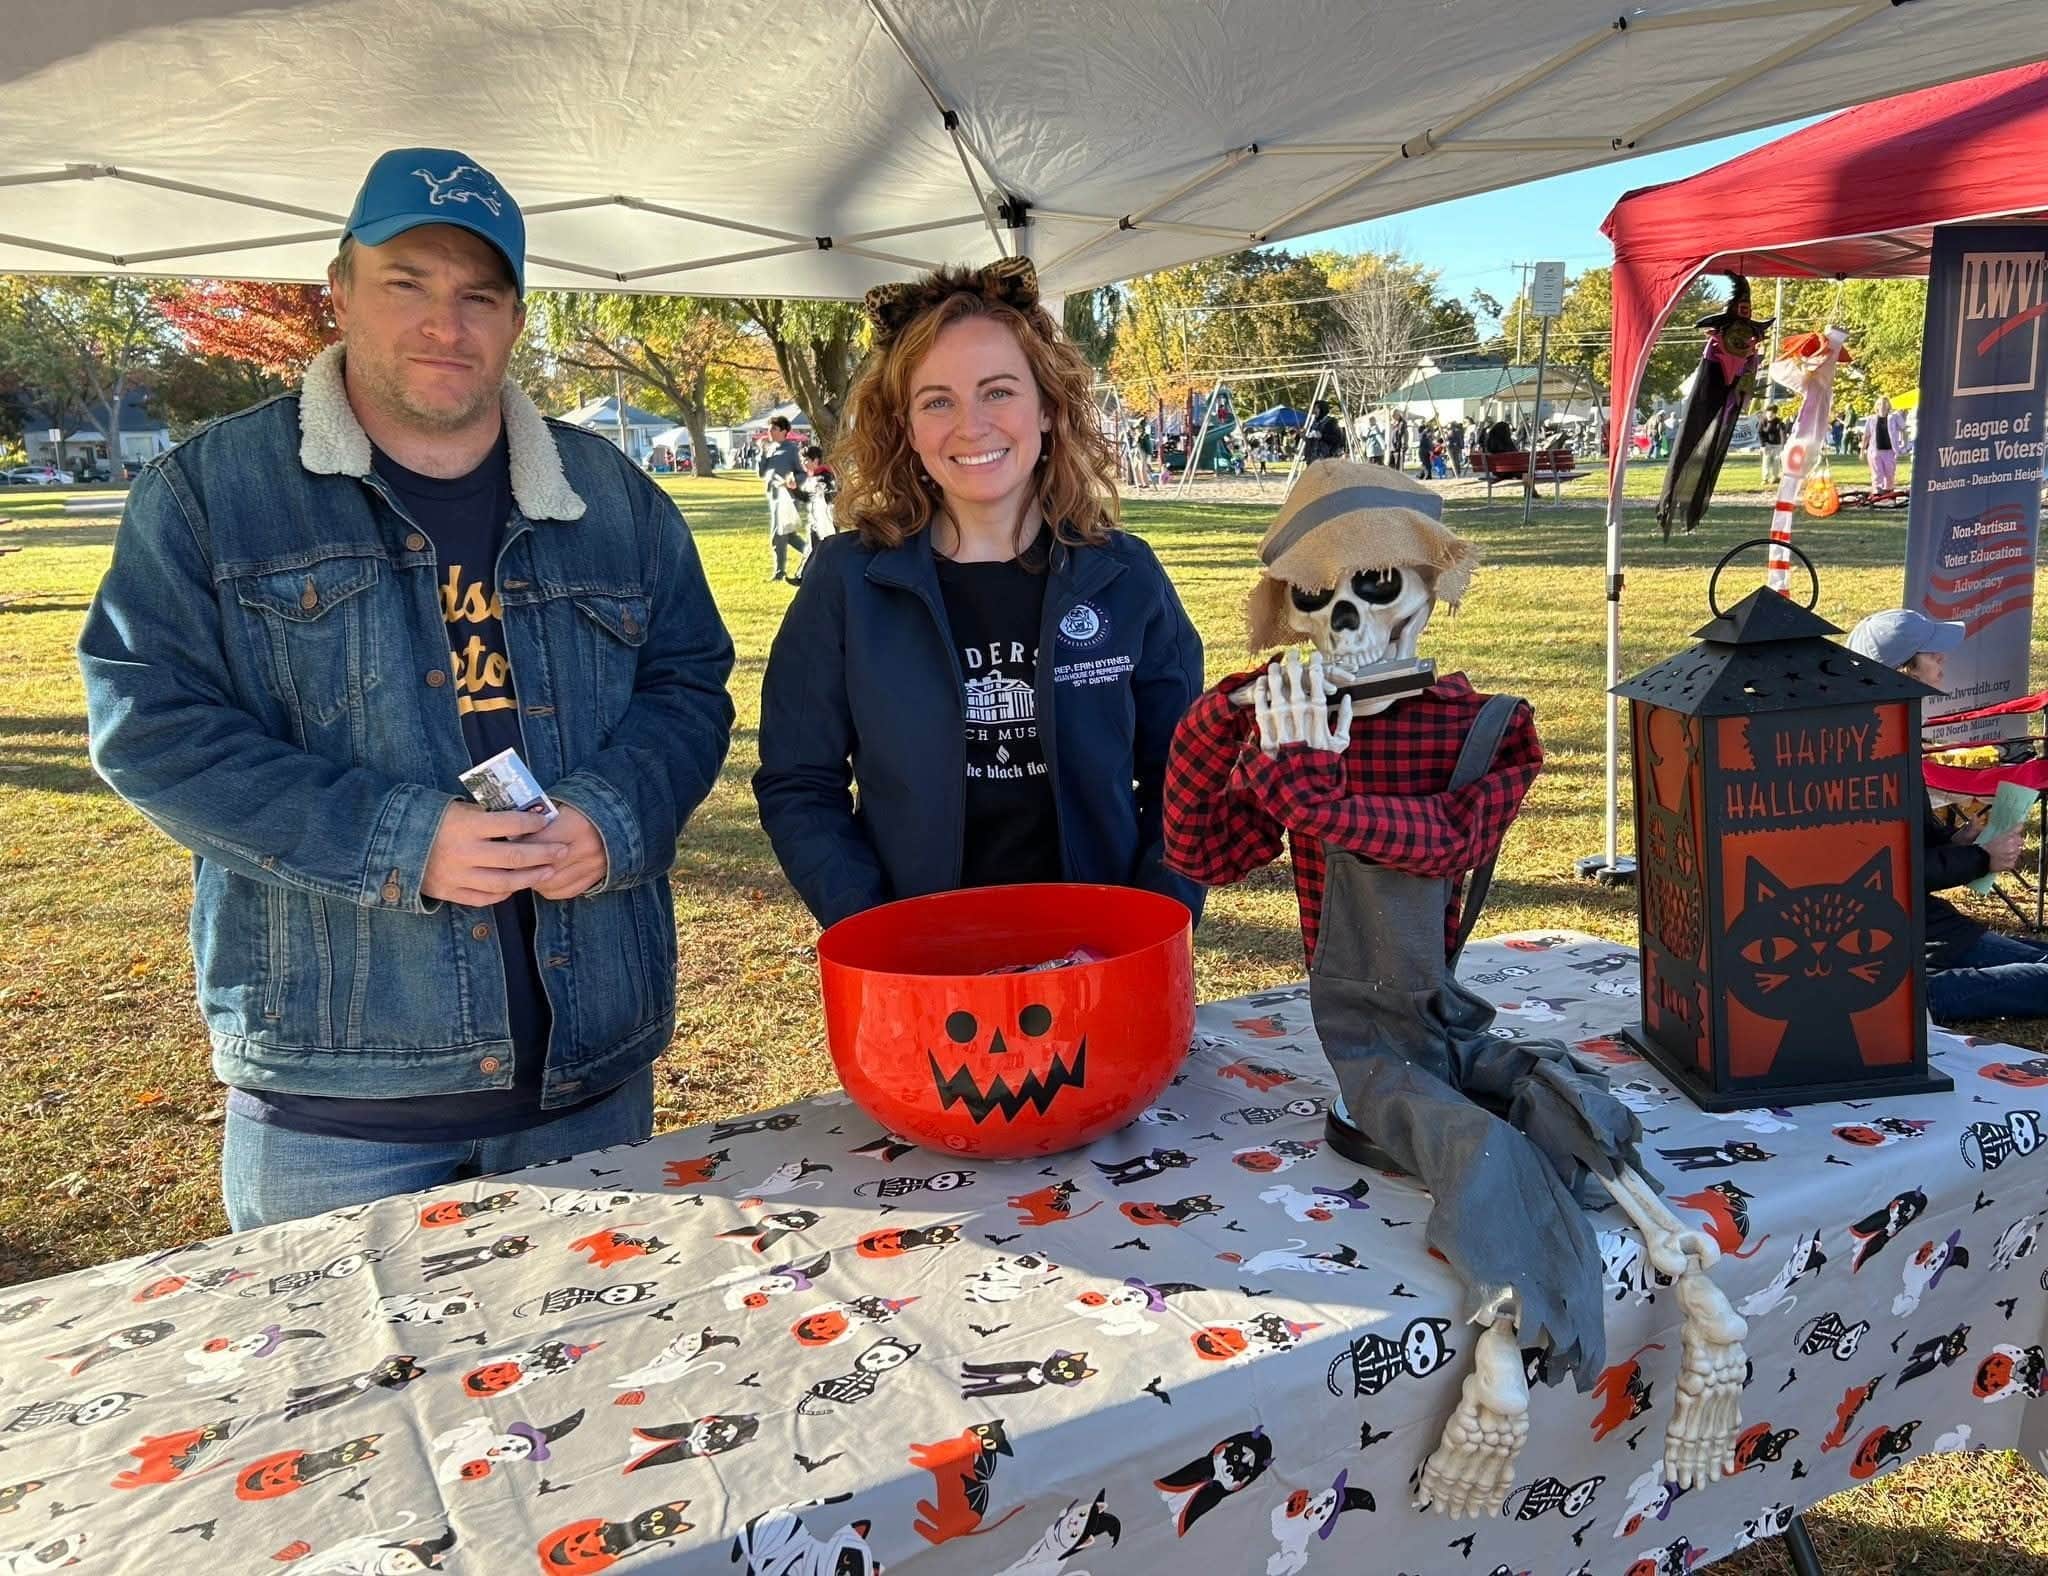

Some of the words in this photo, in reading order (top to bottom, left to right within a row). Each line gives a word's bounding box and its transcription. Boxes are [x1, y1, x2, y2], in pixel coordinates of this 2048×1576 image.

[1967, 258, 2039, 320] LWV
[1954, 419, 2009, 440] League
[2013, 412, 2032, 433] of
[1938, 446, 1990, 468] Women
[1994, 440, 2044, 461] Voters
[1927, 478, 1966, 492] Dearborn
[1972, 472, 2013, 486] Dearborn
[1952, 520, 2017, 540] Non-Partisan
[1944, 553, 1969, 569] Voter
[1969, 545, 2022, 564] Education
[1953, 576, 2005, 593] Advocacy
[1054, 664, 1073, 676] REP.
[1074, 661, 1094, 672] ERIN
[1095, 655, 1131, 668] BYRNES
[1089, 674, 1119, 685] DISTRICT
[998, 727, 1037, 741] MUS
[1946, 723, 1969, 736] North
[1775, 723, 1870, 768] HAPPY
[1727, 772, 1901, 819] HALLOWEEN
